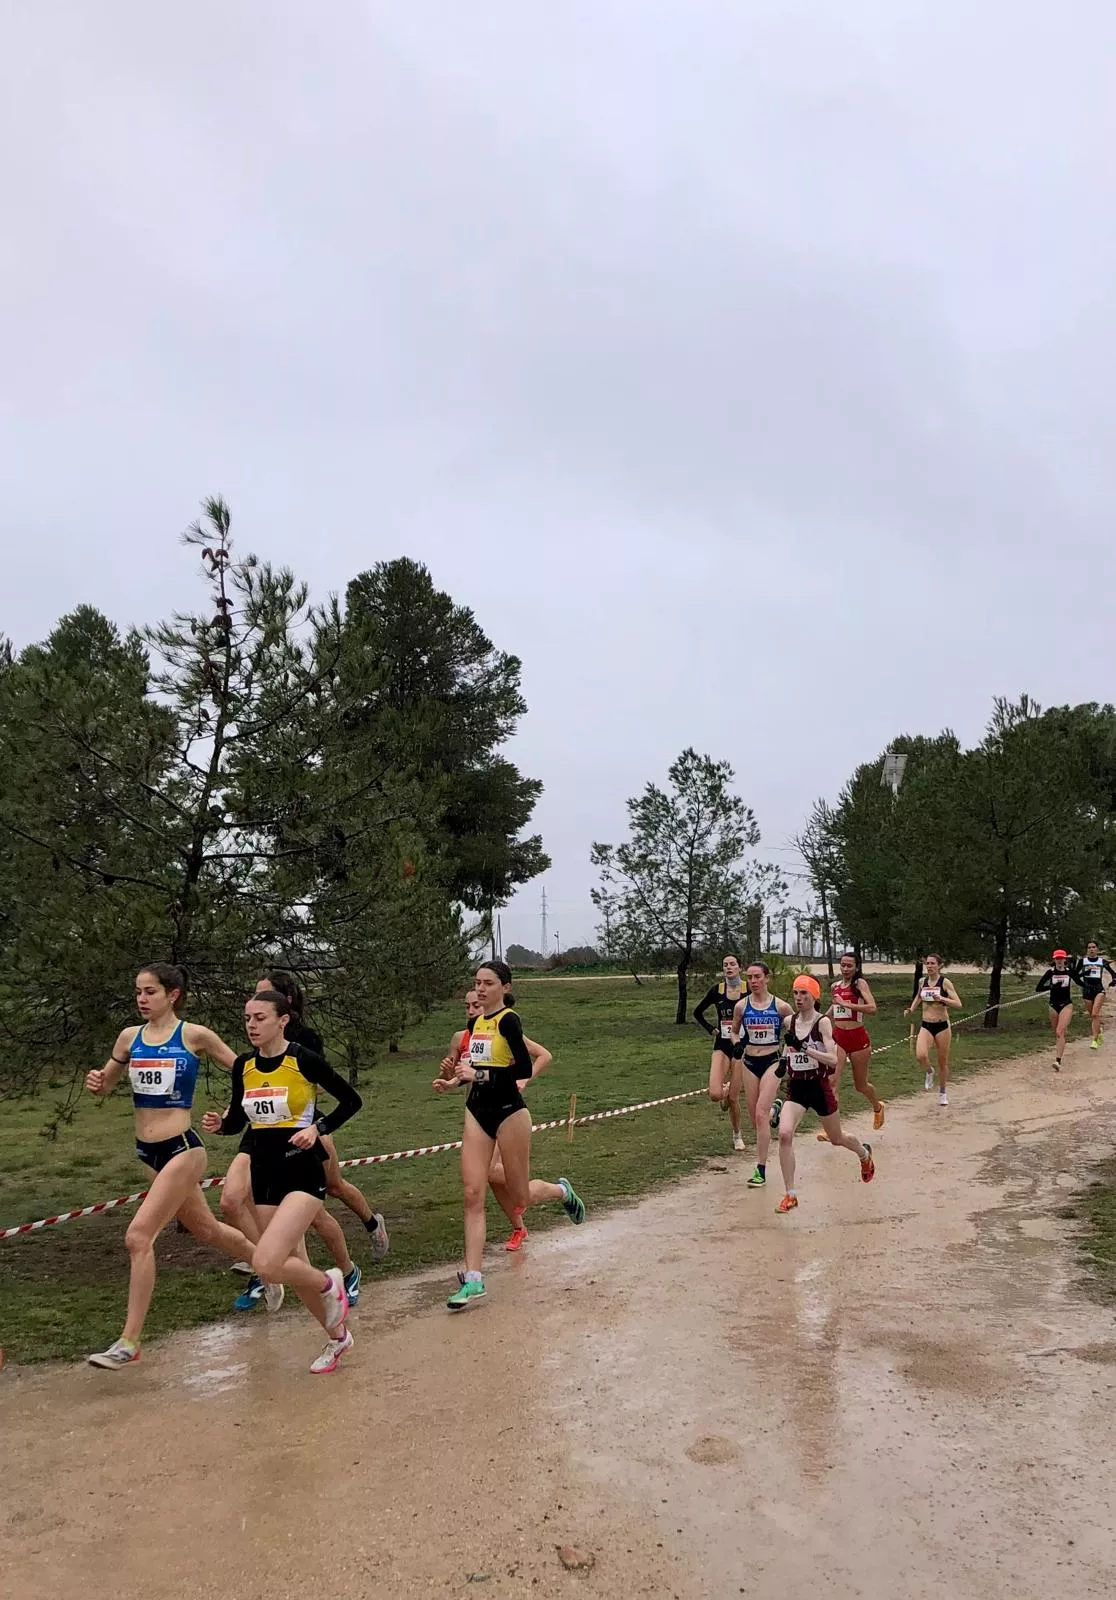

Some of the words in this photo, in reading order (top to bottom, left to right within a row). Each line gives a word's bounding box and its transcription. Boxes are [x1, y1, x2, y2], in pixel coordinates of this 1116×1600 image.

[470, 1042, 485, 1054] 269
[795, 1054, 809, 1064] 226
[138, 1071, 162, 1085] 288
[253, 1100, 275, 1115] 261
